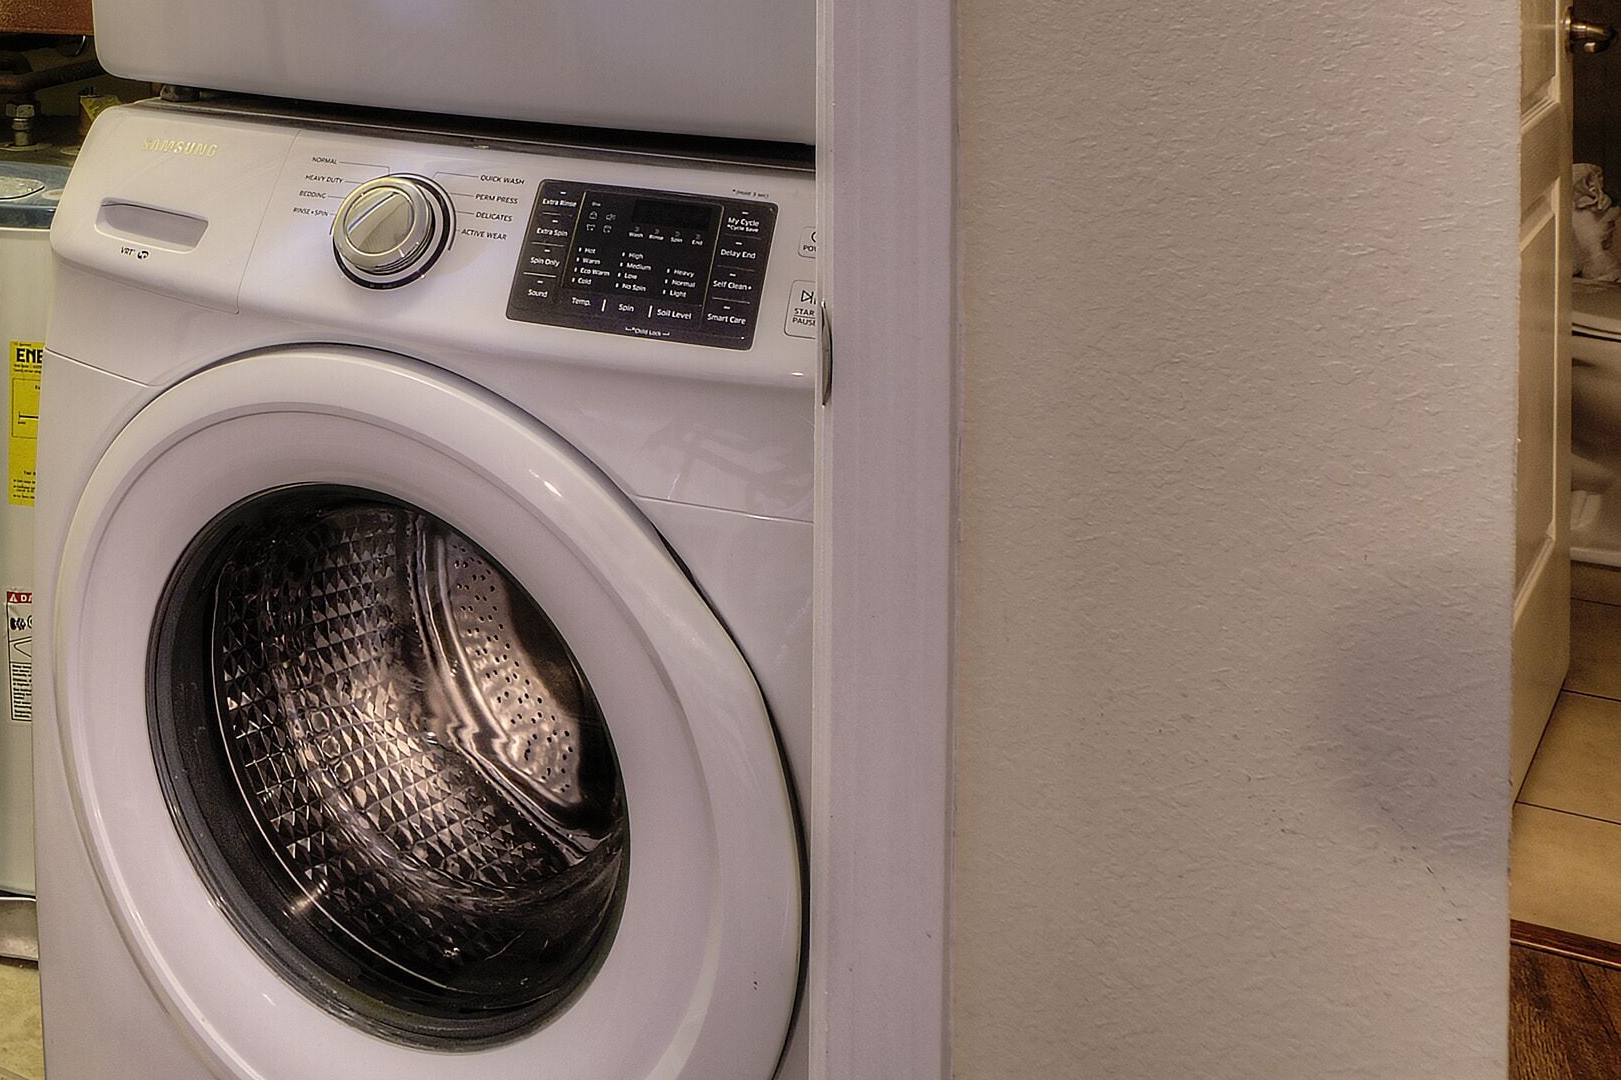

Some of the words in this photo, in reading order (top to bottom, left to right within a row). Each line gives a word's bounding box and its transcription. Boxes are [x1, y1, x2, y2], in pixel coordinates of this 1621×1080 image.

[142, 138, 218, 157] SAMSUNG
[312, 156, 338, 165] NORMAL
[305, 174, 326, 183] HEAVY
[326, 176, 343, 184] DUTY
[480, 174, 503, 184] QUICK
[504, 176, 525, 185] WASH
[299, 190, 326, 200] BEDDING
[475, 193, 496, 202] PERM
[496, 196, 518, 204] PRESS
[542, 198, 558, 206] Extra
[560, 200, 577, 208] Rinse
[475, 211, 513, 222] DELICATES
[728, 217, 740, 226] My
[740, 218, 760, 228] Cycle
[461, 229, 486, 238] ACTIVE
[486, 231, 508, 241] WEAR
[536, 227, 552, 235] Extra
[552, 229, 568, 238] Spin
[628, 252, 644, 261] High
[720, 248, 741, 258] Delay
[742, 251, 756, 260] End
[530, 256, 544, 266] Spin
[545, 259, 560, 268] Only
[626, 262, 652, 271] Medium
[592, 269, 610, 277] Warm
[624, 272, 638, 280] Low
[674, 268, 695, 278] Heavy
[578, 277, 592, 285] Cold
[672, 279, 696, 288] Normal
[713, 280, 726, 288] Self
[528, 288, 548, 298] Sound
[632, 284, 646, 292] Spin
[669, 290, 687, 298] Light
[572, 297, 591, 306] Temp.
[618, 303, 635, 313] Spin
[794, 307, 815, 317] STAR
[656, 308, 671, 318] Soil
[672, 310, 692, 320] Level
[707, 313, 728, 323] Smart
[729, 316, 746, 325] Care
